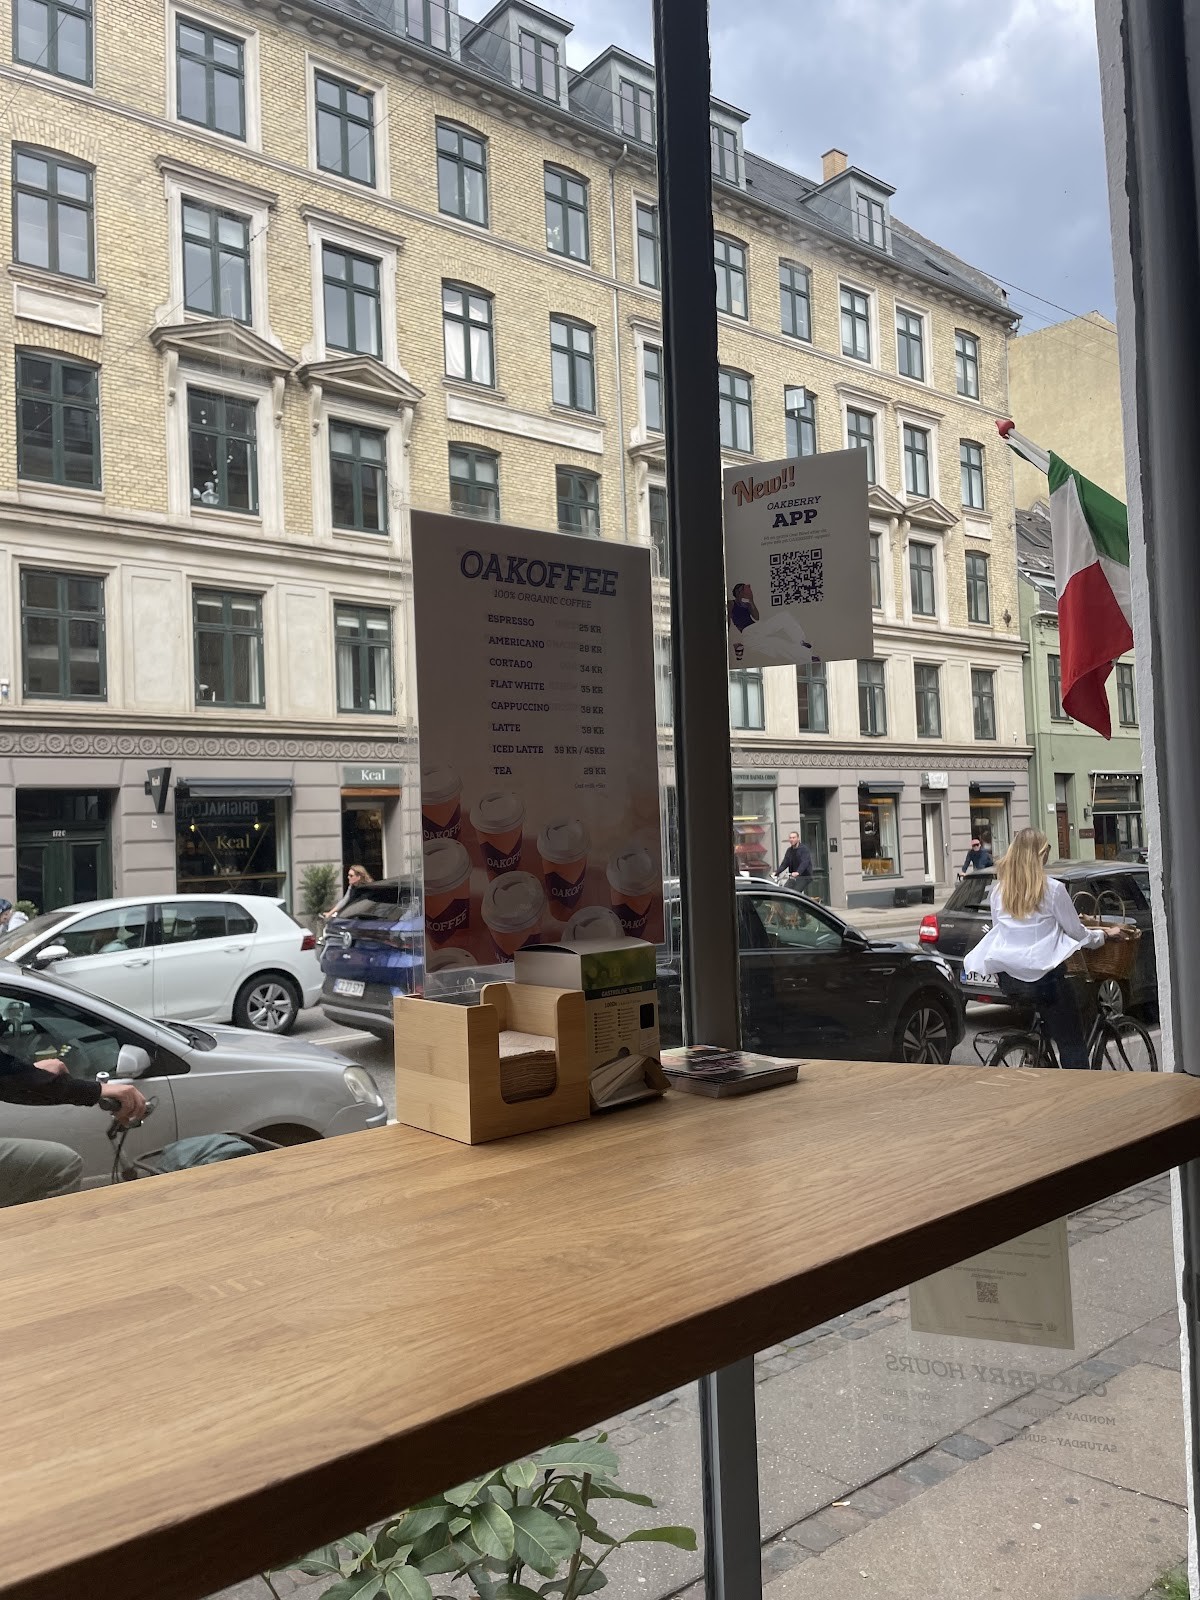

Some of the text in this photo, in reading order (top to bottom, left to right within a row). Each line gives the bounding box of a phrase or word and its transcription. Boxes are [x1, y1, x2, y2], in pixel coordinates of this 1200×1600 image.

[732, 465, 796, 507] New!!
[767, 495, 821, 511] OAKBERRY
[772, 508, 818, 528] APP
[460, 550, 619, 597] OAKOFFEE
[493, 589, 592, 609] 100% ORGANIC COFFEE
[488, 614, 602, 634] ESPRESSO 25 KR
[488, 636, 545, 649] AMERICANO
[591, 645, 602, 654] KR
[489, 658, 603, 674] CORTADO 34 KR
[490, 679, 603, 694] FLAT WHITE 35 KR
[491, 701, 604, 715] CAPPUCCINO 38 KR
[492, 723, 605, 735] LATTE 38 KR
[493, 745, 514, 754] ICED
[515, 745, 544, 754] LATTE
[554, 746, 565, 754] 39
[566, 746, 578, 754] KR
[361, 769, 386, 781] Kcal
[493, 766, 607, 775] TEA 29 KR
[216, 833, 250, 849] Kcal
